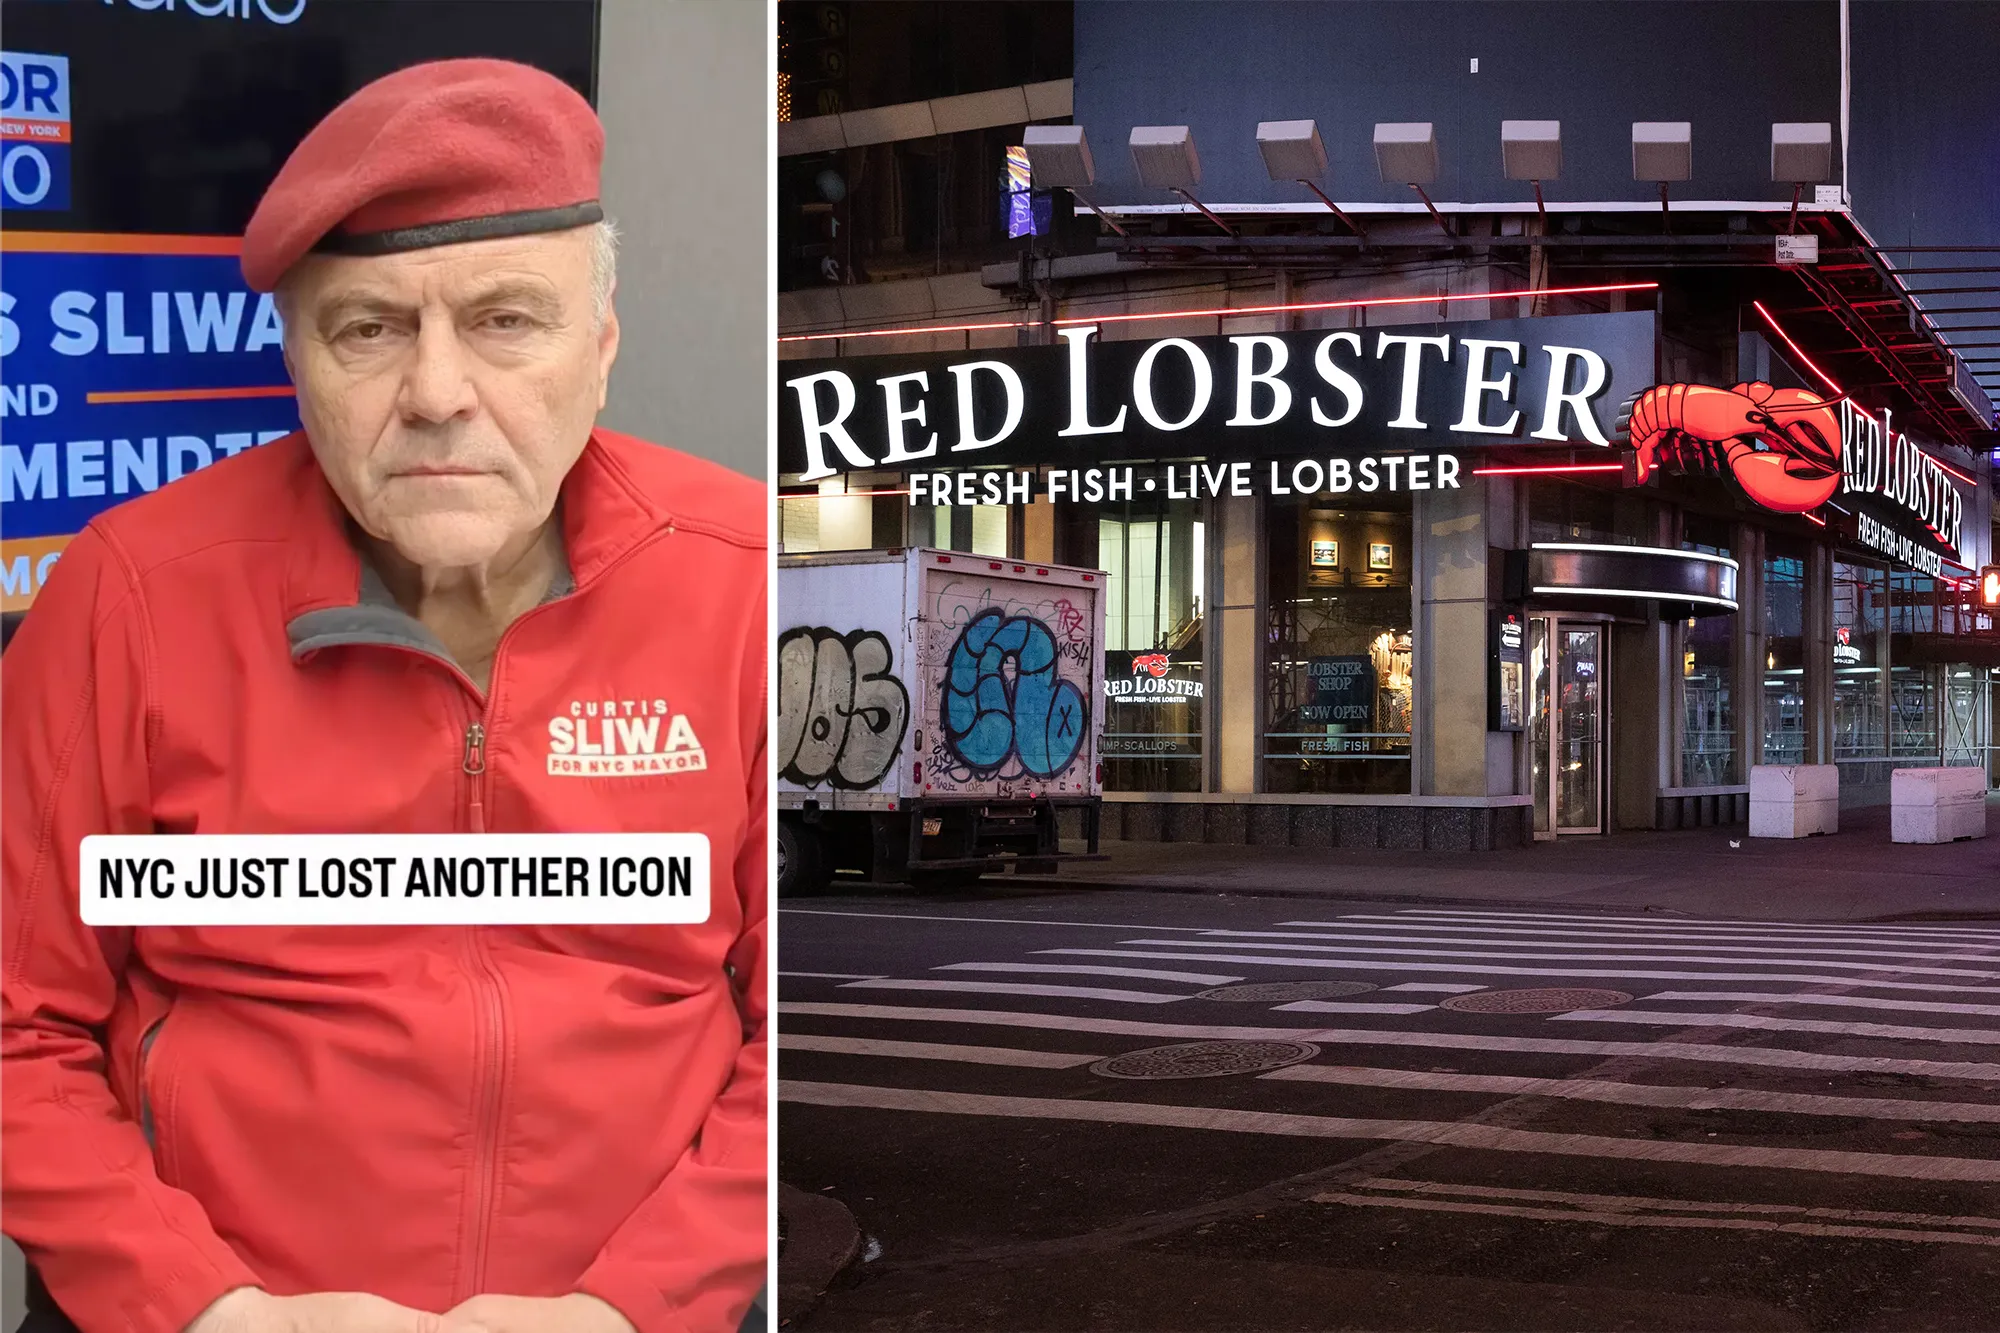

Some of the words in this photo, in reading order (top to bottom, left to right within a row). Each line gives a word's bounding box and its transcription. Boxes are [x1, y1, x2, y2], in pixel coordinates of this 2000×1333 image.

[29, 125, 62, 137] YORK
[50, 290, 285, 357] SLIWA
[787, 360, 1024, 483] RED
[1058, 326, 1610, 447] LOBSTER
[0, 430, 290, 502] MENDT
[1841, 397, 1880, 495] RED
[1884, 407, 1962, 556] LOBSTER
[909, 471, 1029, 508] FRESH
[1049, 467, 1133, 504] FISH
[1167, 463, 1251, 499] LIVE
[1271, 455, 1461, 495] LOBSTER
[1857, 511, 1880, 549] FRESH
[1880, 525, 1896, 555] FISH
[1898, 533, 1914, 564] LIVE
[1913, 543, 1942, 579] LOBSTER
[1306, 661, 1364, 676] LOBSTER
[1103, 679, 1132, 697] RED
[1135, 675, 1204, 698] LOBSTER
[1318, 676, 1352, 691] SHOP
[570, 698, 668, 718] CURTIS
[1300, 705, 1331, 720] NOW
[1333, 705, 1369, 719] OPEN
[547, 714, 702, 756] SLIWA
[1301, 741, 1338, 753] FRESH
[1343, 740, 1370, 752] FISH
[551, 758, 582, 772] FOR
[589, 759, 625, 773] NYC
[633, 755, 702, 772] MAYOR
